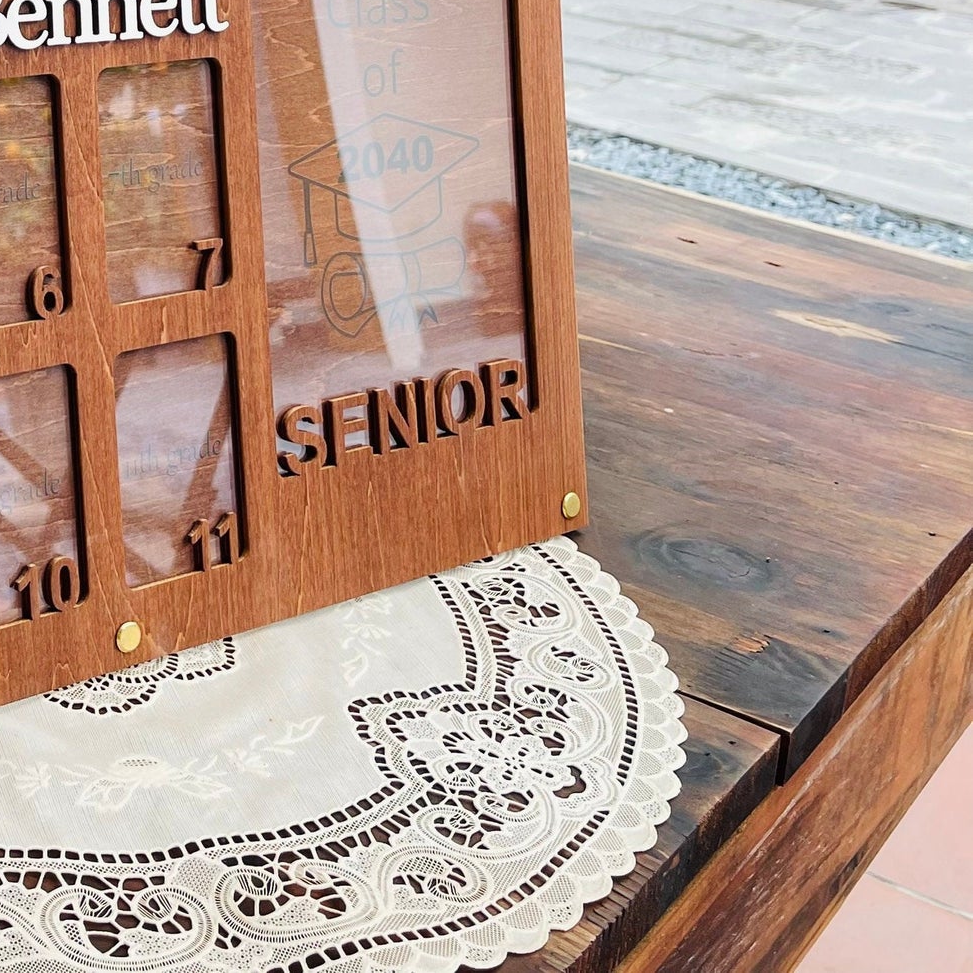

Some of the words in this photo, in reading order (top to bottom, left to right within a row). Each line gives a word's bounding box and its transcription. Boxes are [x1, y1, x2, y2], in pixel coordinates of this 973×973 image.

[362, 49, 404, 99] of
[148, 150, 203, 193] grade
[339, 133, 435, 185] 2040
[192, 237, 224, 291] 7
[26, 265, 64, 321] 6
[276, 357, 528, 479] SENIOR
[186, 511, 240, 573] 11
[9, 555, 82, 622] 10
